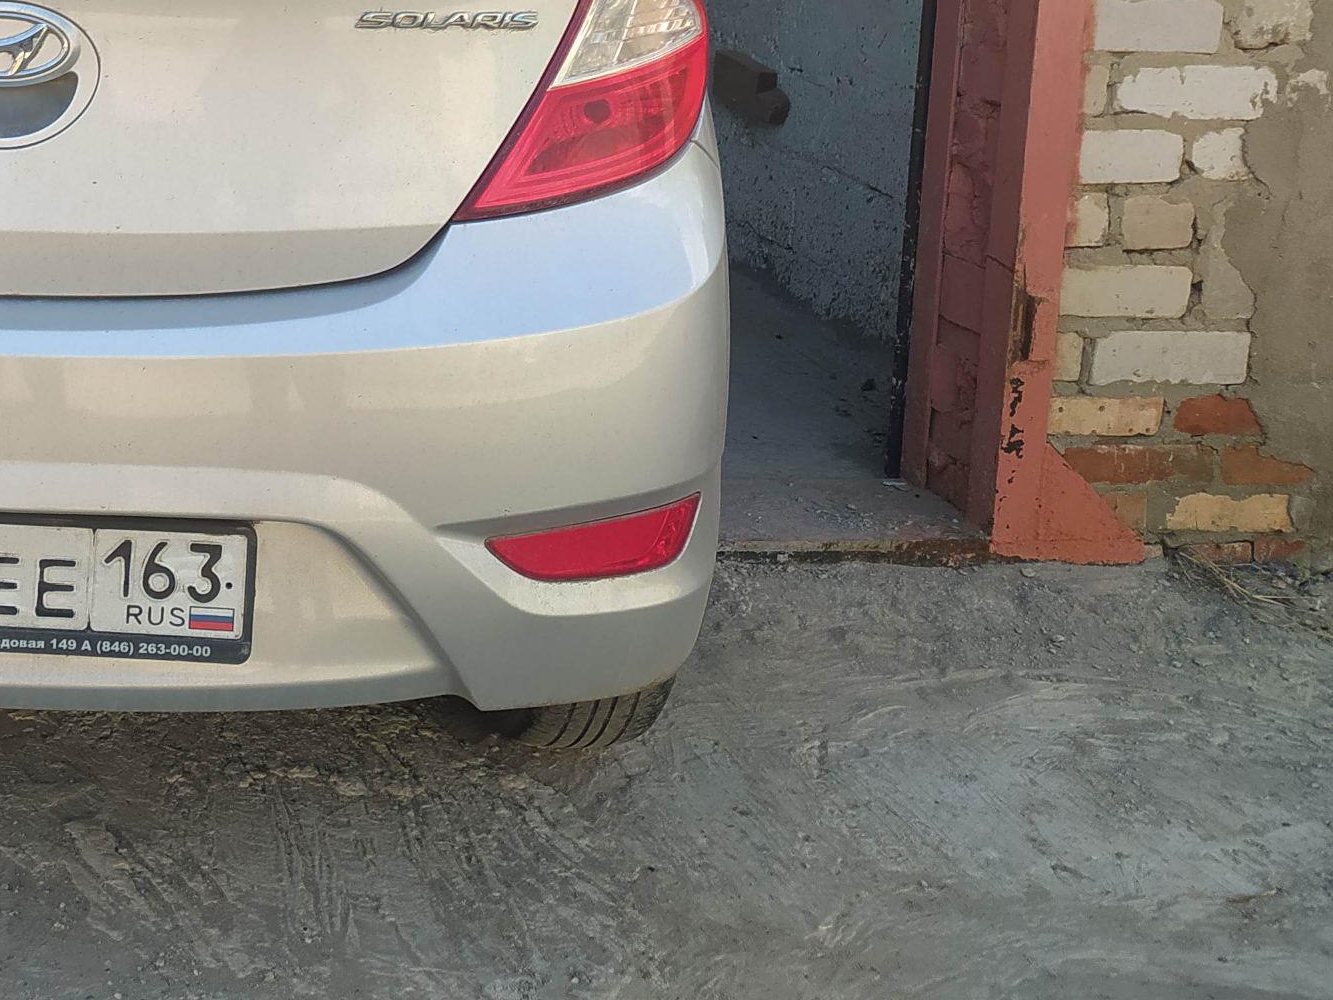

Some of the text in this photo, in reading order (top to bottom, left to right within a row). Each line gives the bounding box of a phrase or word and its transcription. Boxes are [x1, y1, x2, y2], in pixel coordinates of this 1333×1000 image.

[354, 9, 540, 31] SOLARIS
[104, 538, 224, 604] 163
[125, 604, 186, 627] RUS
[49, 637, 77, 651] 149
[96, 641, 134, 656] (846)
[138, 642, 212, 658] 263-00-00
